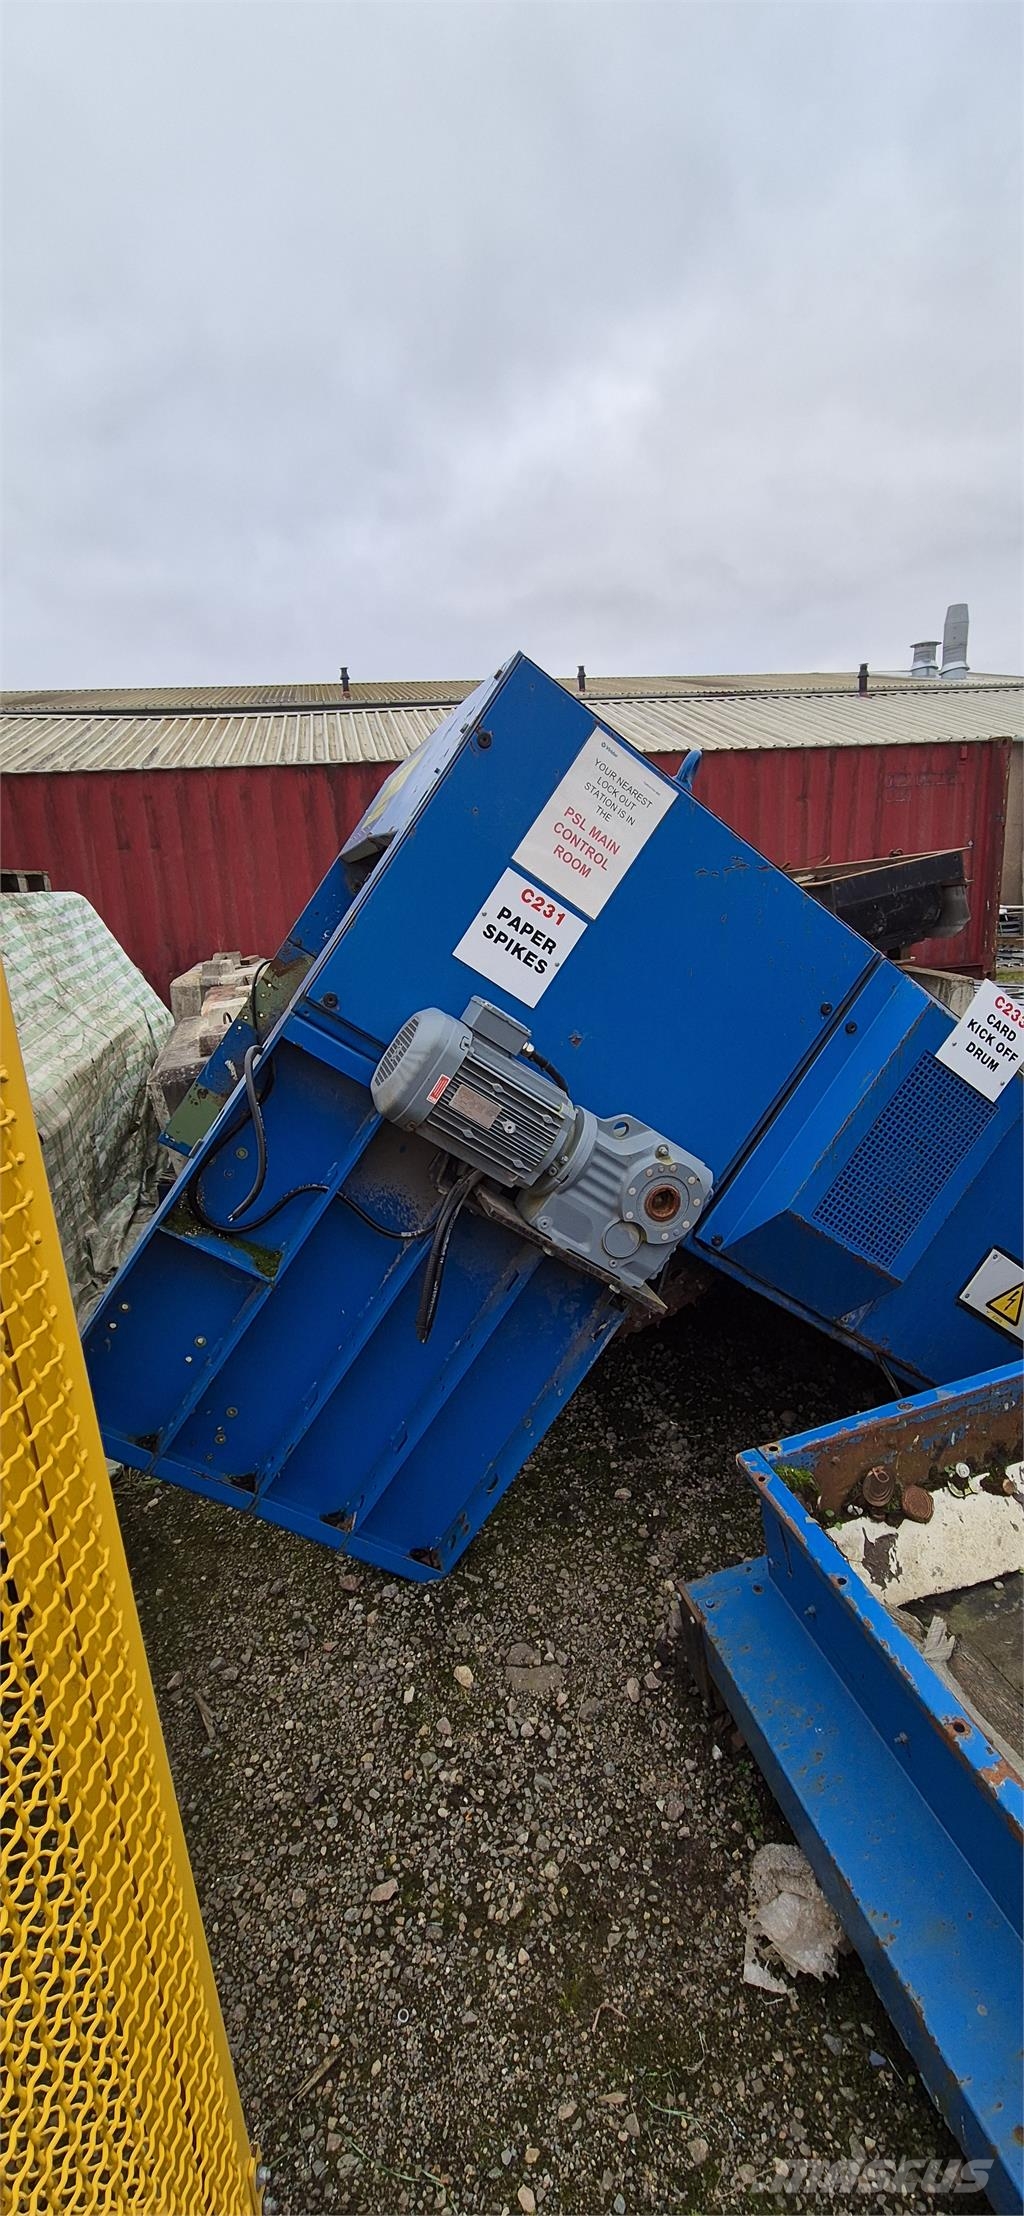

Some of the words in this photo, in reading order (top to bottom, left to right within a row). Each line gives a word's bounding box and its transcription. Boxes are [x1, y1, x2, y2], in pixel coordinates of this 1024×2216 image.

[584, 781, 617, 812] STATION
[617, 807, 627, 819] IS
[625, 815, 637, 826] IN
[594, 758, 617, 780] YOUR
[616, 776, 653, 809] NEAREST
[596, 776, 618, 799] LOCK
[618, 794, 637, 811] OUT
[564, 806, 586, 831] PSL
[588, 825, 621, 855] MAIN
[595, 805, 612, 822] THE
[553, 822, 609, 871] CONTROL
[553, 844, 592, 878] ROOM
[520, 888, 566, 926] C231
[482, 923, 548, 974] SPIKES
[496, 906, 557, 955] PAPER
[967, 1018, 996, 1047] KICK
[995, 1043, 1019, 1063] OFF
[987, 1013, 1017, 1042] CARD
[965, 1041, 1000, 1073] DRUM
